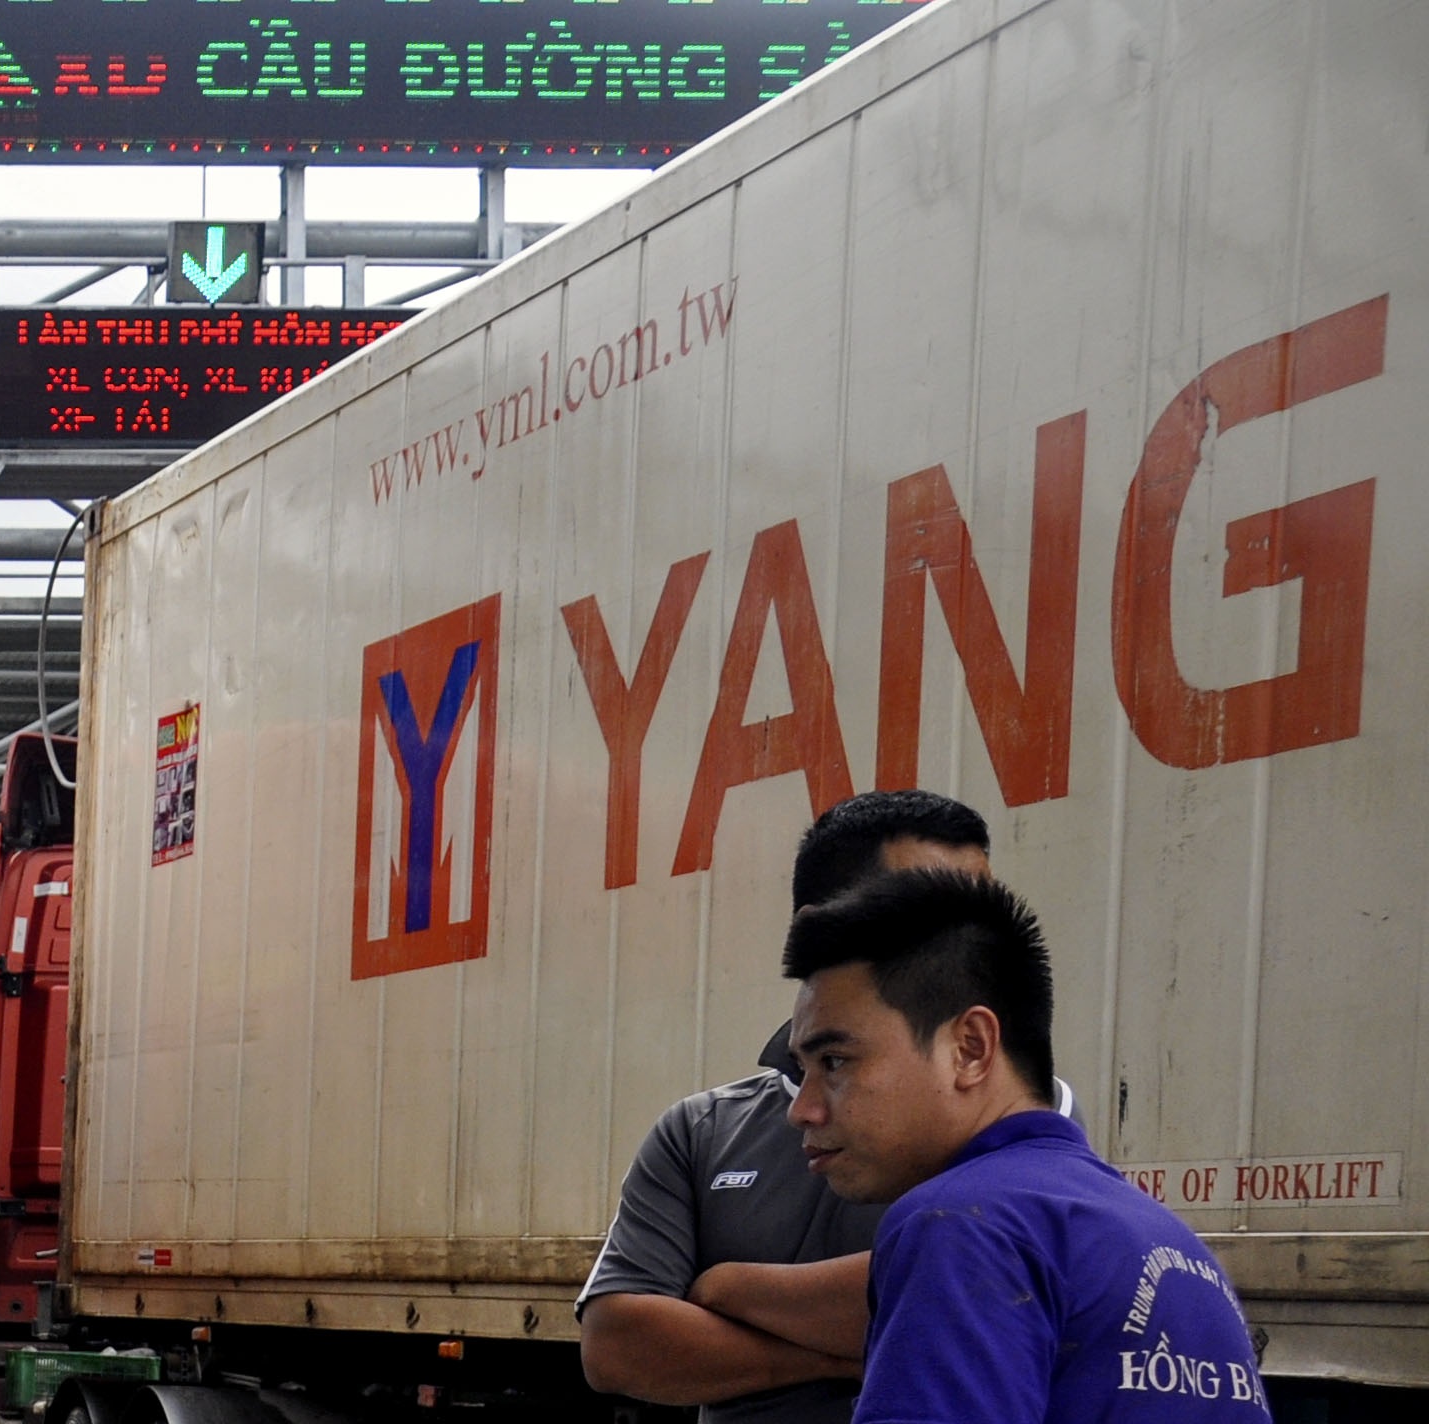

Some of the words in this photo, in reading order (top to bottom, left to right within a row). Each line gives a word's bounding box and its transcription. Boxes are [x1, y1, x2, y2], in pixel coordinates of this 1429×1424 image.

[196, 18, 367, 98] CẦU
[399, 18, 726, 100] ĐƯỜNG
[95, 319, 171, 346] THU
[369, 274, 740, 507] www.yml.com.tw
[559, 291, 1391, 892] YANG
[1181, 1167, 1218, 1203] OF
[1234, 1160, 1384, 1202] FORKLIFT
[1122, 1276, 1156, 1335] TRUNG
[1117, 1331, 1221, 1399] HỒNG
